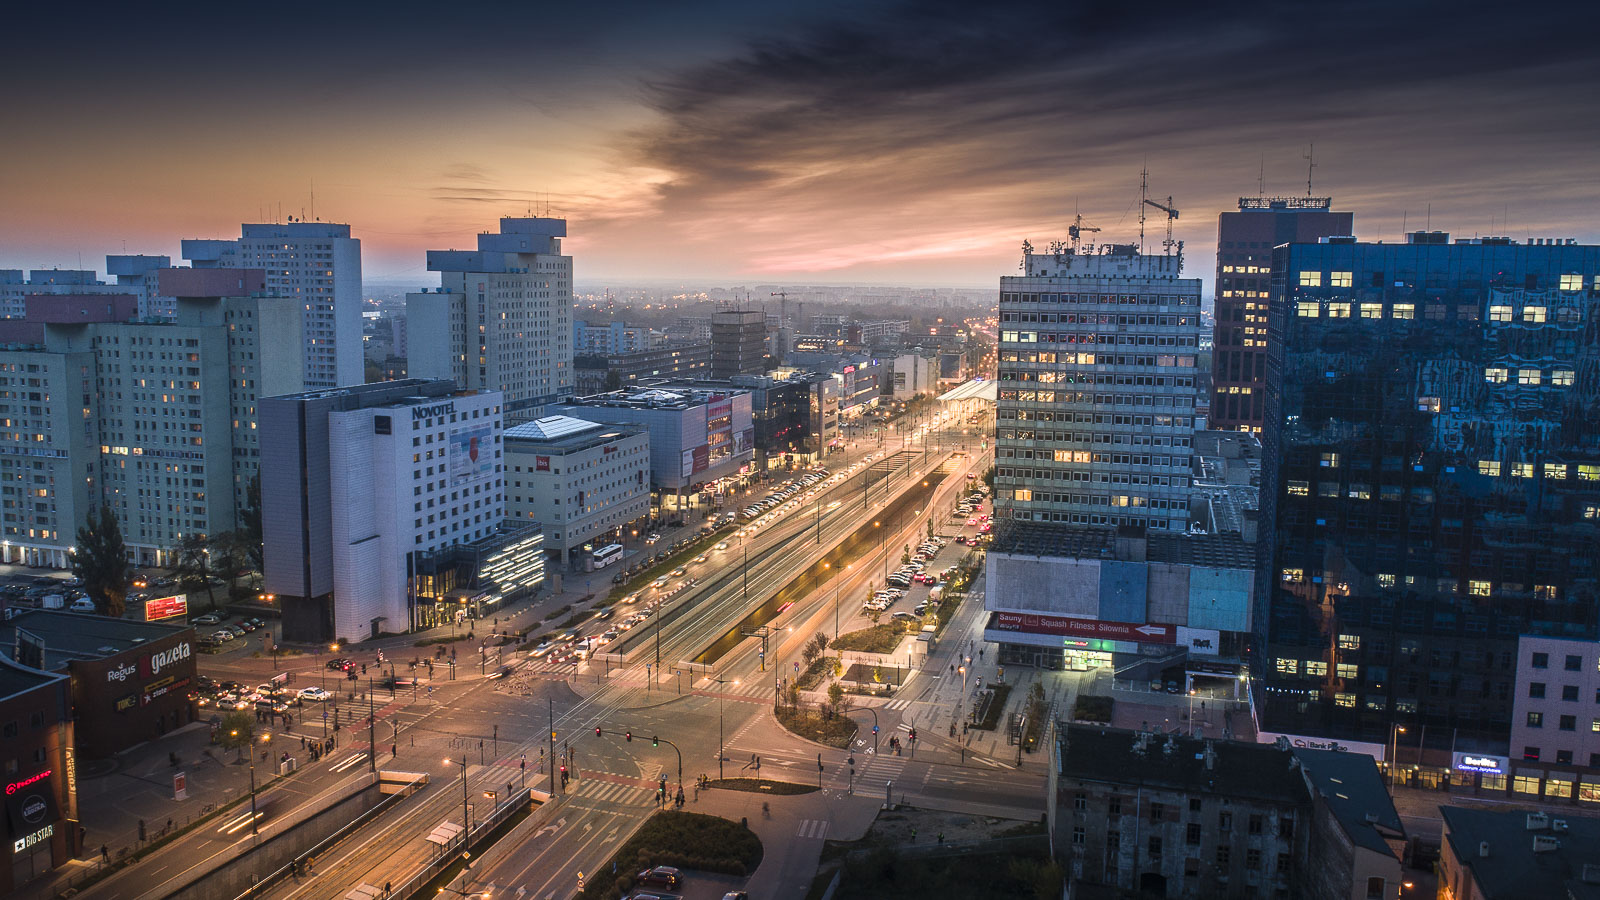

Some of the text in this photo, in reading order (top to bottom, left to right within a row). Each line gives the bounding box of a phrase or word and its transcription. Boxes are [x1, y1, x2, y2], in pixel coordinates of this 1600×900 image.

[412, 401, 457, 420] NOVOTEL
[537, 459, 548, 467] ibis
[999, 613, 1023, 623] Sauny
[1040, 618, 1067, 629] Squash
[1069, 621, 1096, 631] Fitness
[151, 642, 191, 674] gazeta
[107, 664, 136, 682] Regus
[1309, 741, 1348, 752] Bank Pao
[26, 824, 54, 848] BIG STAR
